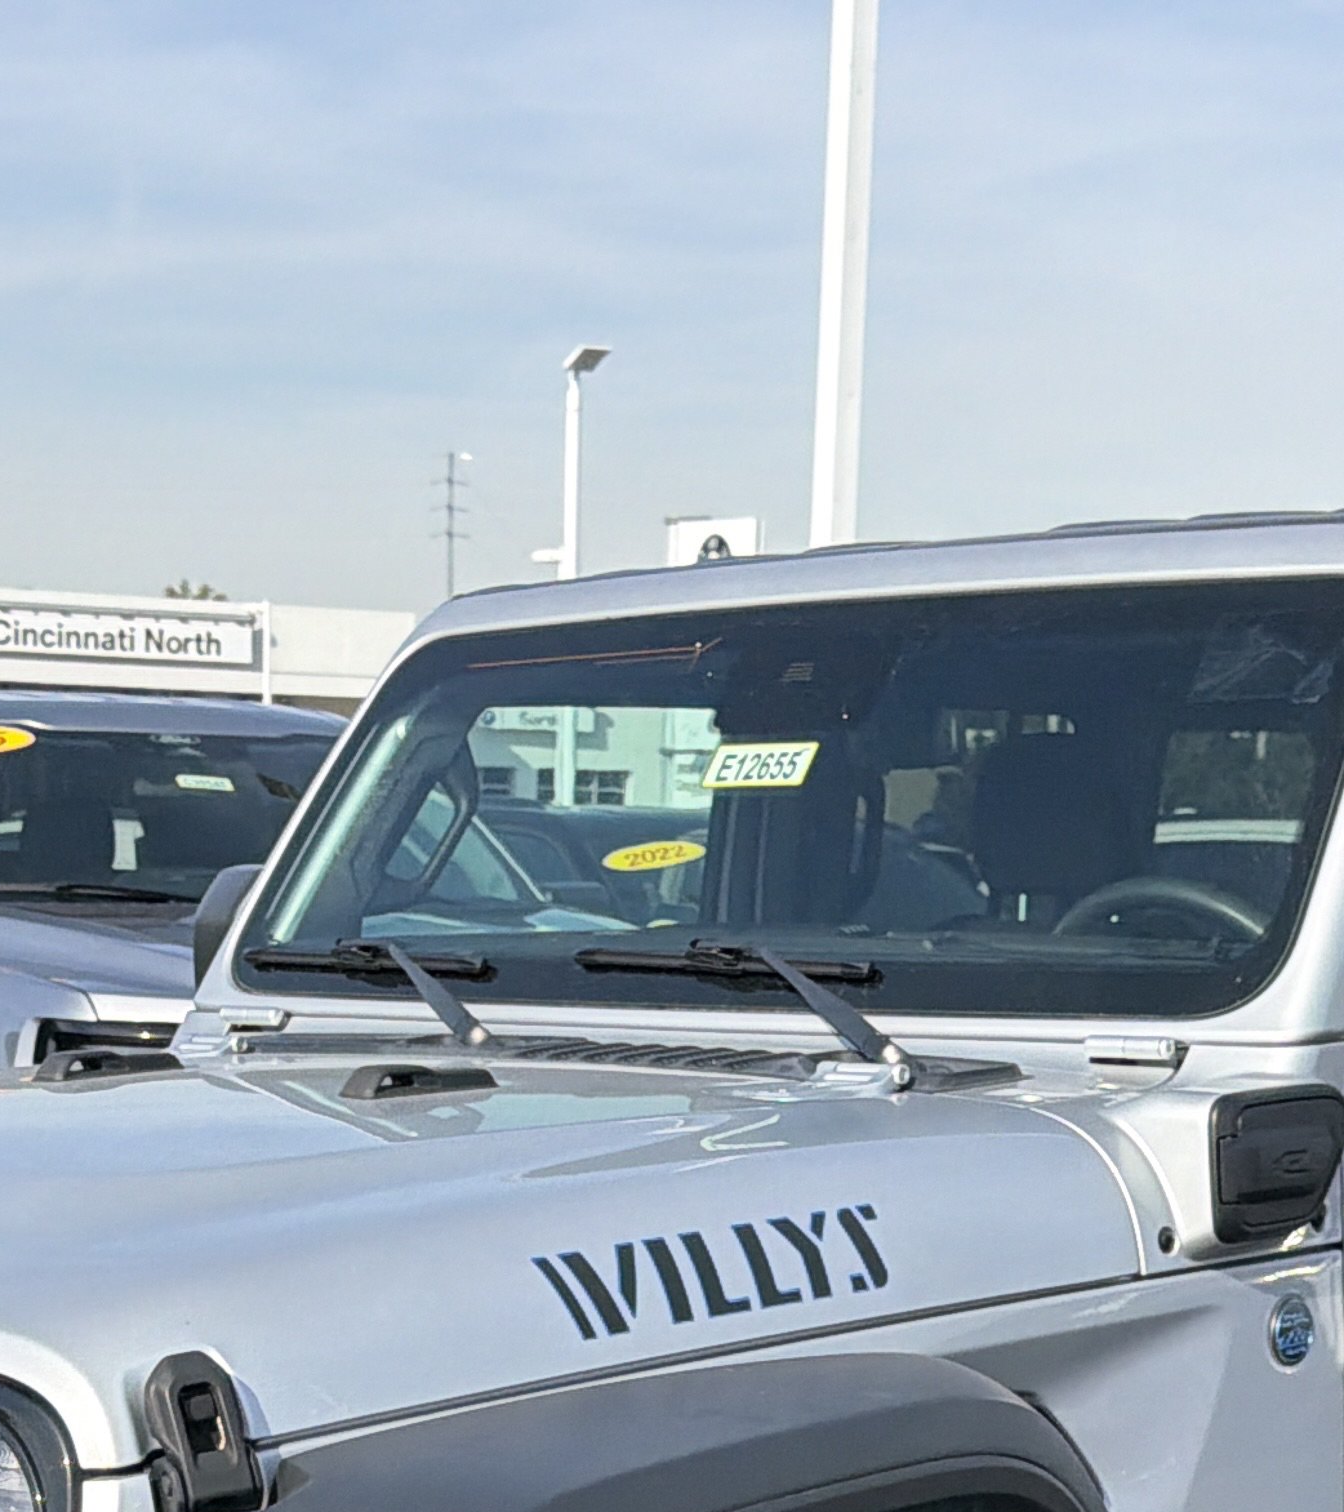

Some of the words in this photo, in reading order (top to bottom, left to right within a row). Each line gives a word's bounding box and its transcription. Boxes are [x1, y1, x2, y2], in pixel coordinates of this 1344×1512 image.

[144, 629, 222, 656] North
[715, 752, 803, 782] E12655
[624, 845, 687, 867] 2022
[530, 1203, 889, 1341] WILLYS
